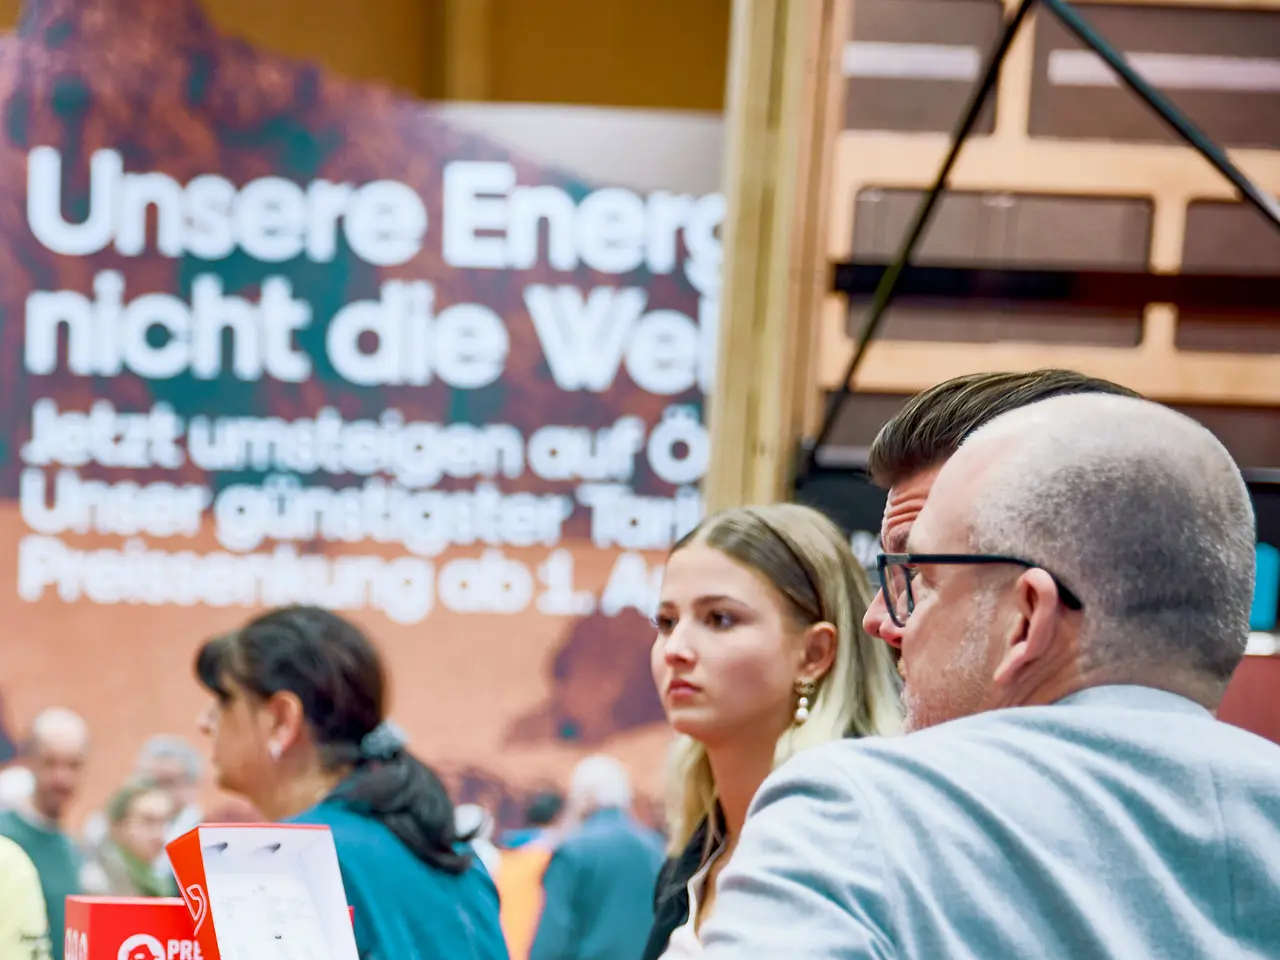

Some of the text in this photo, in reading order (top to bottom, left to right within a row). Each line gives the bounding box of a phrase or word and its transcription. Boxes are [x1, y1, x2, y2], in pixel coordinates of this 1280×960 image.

[26, 145, 427, 266] Unsere
[24, 271, 312, 383] nicht
[326, 279, 509, 389] die
[20, 398, 186, 470] Jetzt
[187, 406, 524, 487] umsteigen
[527, 414, 645, 480] auf
[20, 466, 212, 538] Unser
[213, 472, 574, 553] günstigster
[17, 533, 436, 624] Preissenkung
[437, 548, 534, 614] ab
[535, 548, 596, 616] 1.
